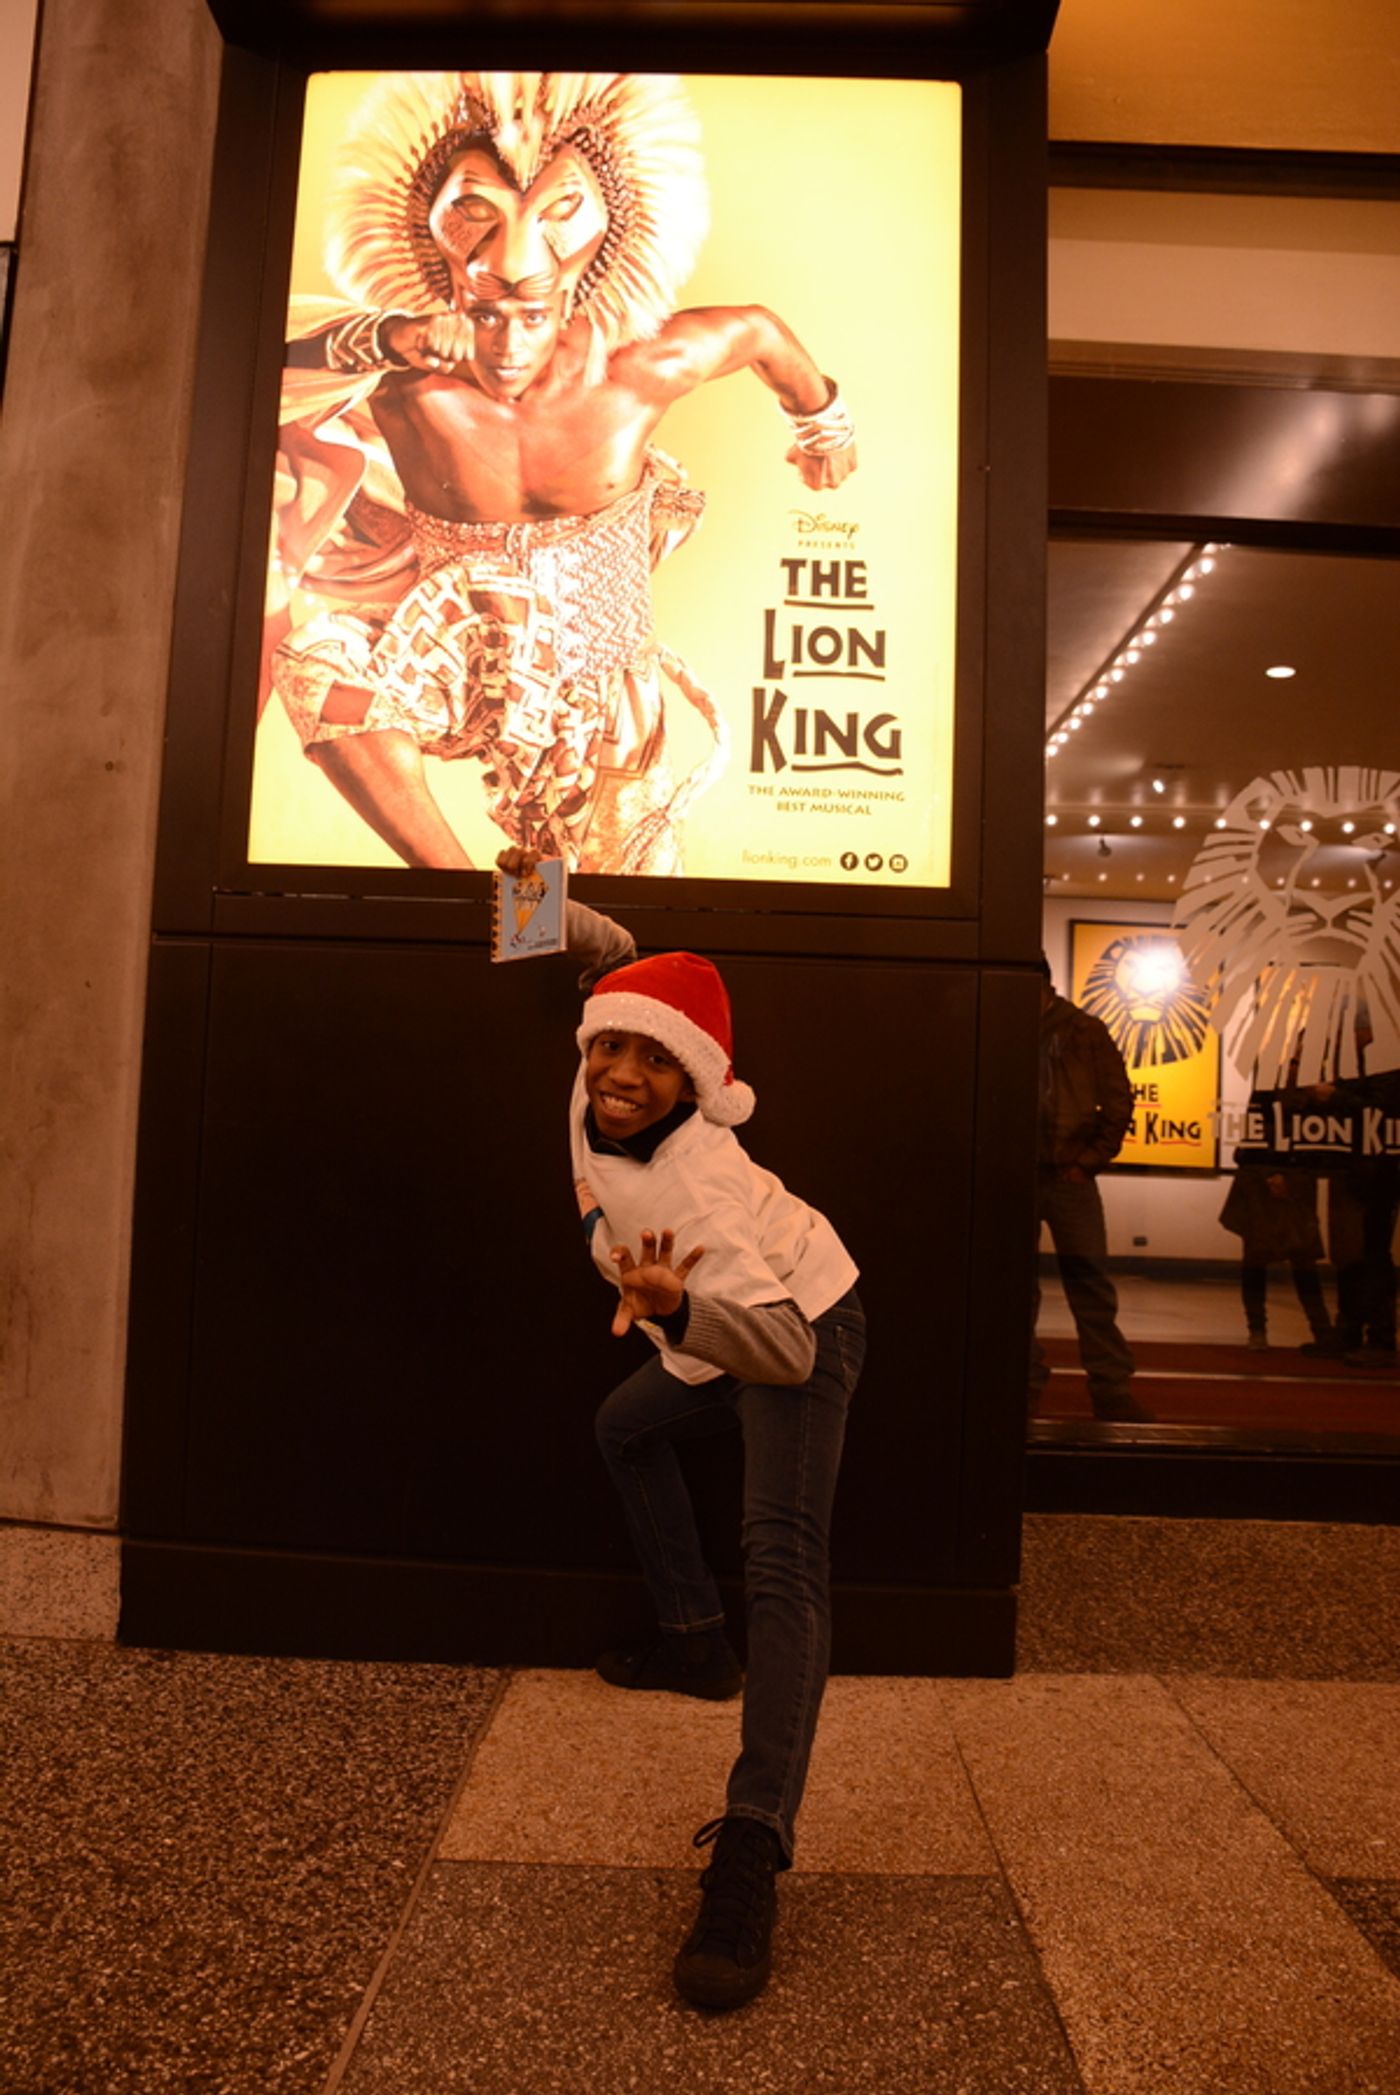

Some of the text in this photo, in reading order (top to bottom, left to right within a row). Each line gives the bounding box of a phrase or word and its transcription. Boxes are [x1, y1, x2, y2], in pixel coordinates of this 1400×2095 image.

[780, 558, 867, 599] THE
[763, 608, 885, 680] LION
[750, 687, 901, 773] KING
[748, 784, 774, 796] THE
[777, 802, 871, 816] BEST MUSICAL
[742, 850, 832, 869] lionking.com
[1130, 1083, 1158, 1102] HE
[1145, 1111, 1201, 1145] KING
[1207, 1111, 1264, 1140] THE
[1272, 1101, 1352, 1152] LION
